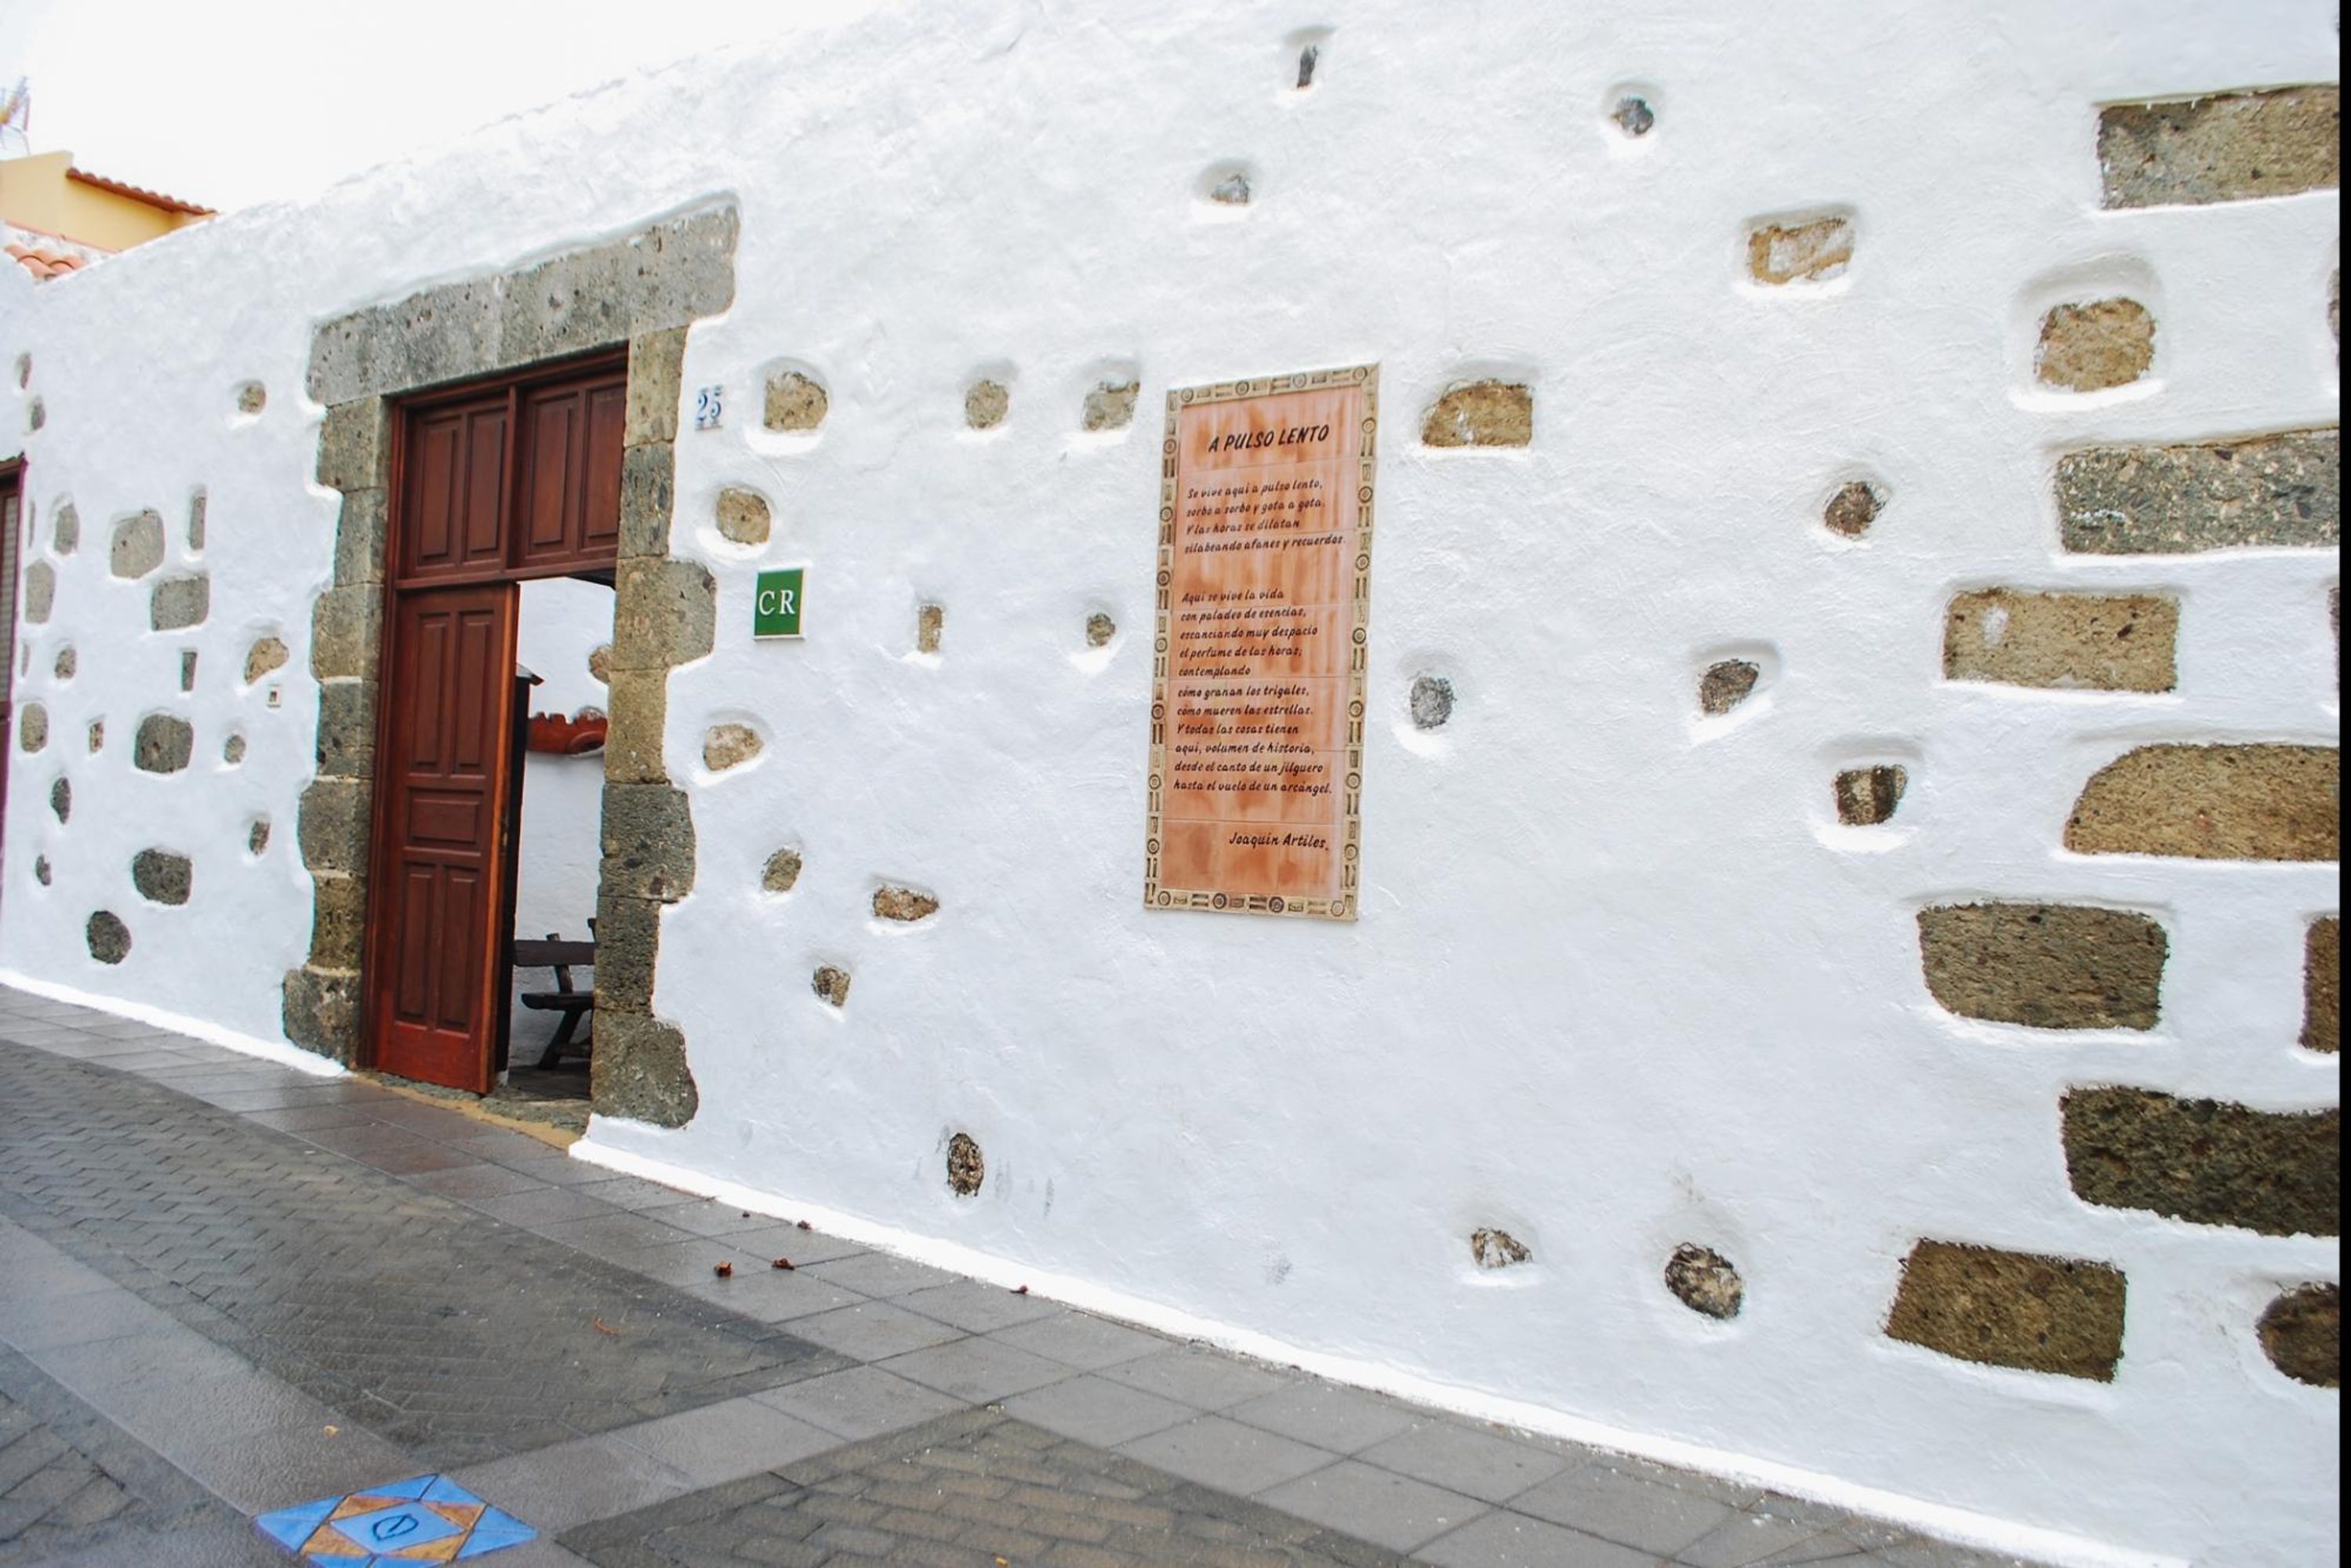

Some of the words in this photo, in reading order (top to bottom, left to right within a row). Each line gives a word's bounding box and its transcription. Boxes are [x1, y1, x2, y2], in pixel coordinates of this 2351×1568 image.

[697, 385, 722, 424] 25
[1208, 435, 1219, 452] A
[1223, 430, 1274, 451] PULSO
[1278, 424, 1329, 445] LENTO
[1187, 488, 1198, 499] Se
[1201, 488, 1223, 498] vive
[1260, 480, 1290, 495] pulso
[1292, 480, 1323, 490] lento,
[1186, 506, 1212, 517] sorbo
[1224, 503, 1251, 514] sorbo
[1253, 504, 1259, 514] y
[1262, 500, 1285, 514] gota
[1194, 524, 1210, 534] las
[1212, 522, 1241, 533] horas
[1257, 519, 1299, 530] dilatan
[1185, 540, 1241, 554] silabeando
[1244, 537, 1280, 550] afanes
[1283, 539, 1289, 550] y
[1220, 590, 1242, 601] vive
[1245, 589, 1255, 600] la
[1259, 587, 1284, 599] vida
[1198, 608, 1241, 624] paladeo
[1245, 608, 1256, 619] de
[1259, 606, 1306, 618] esencias,
[1180, 627, 1244, 640] escanciando
[1246, 630, 1269, 640] muy
[1271, 625, 1317, 640] despacio
[1179, 647, 1190, 658] el
[1190, 646, 1232, 661] perfume
[1234, 645, 1247, 657] de
[1249, 646, 1266, 656] las
[1179, 665, 1251, 679] contemplando
[1204, 688, 1242, 700] granan
[1246, 684, 1261, 696] los
[1263, 684, 1309, 699] trigales,
[1204, 706, 1241, 716] mueren
[1244, 703, 1261, 715] las
[1177, 723, 1185, 734] Y
[1185, 723, 1214, 735] todas
[1216, 724, 1233, 734] las
[1235, 725, 1263, 734] cosas
[1265, 723, 1299, 734] tienen
[1205, 741, 1248, 753] volumen
[1252, 741, 1265, 753] de
[1267, 742, 1314, 755] historia,
[1175, 761, 1203, 771] desde
[1205, 761, 1215, 771] el
[1217, 762, 1247, 771] canto
[1249, 761, 1262, 771] de
[1263, 764, 1277, 772] un
[1277, 761, 1324, 777] jilguero
[1173, 779, 1204, 790] hasta
[1206, 780, 1216, 790] el
[1219, 780, 1247, 790] vuelo
[1249, 781, 1262, 790] de
[1282, 833, 1329, 851] Artiles.
